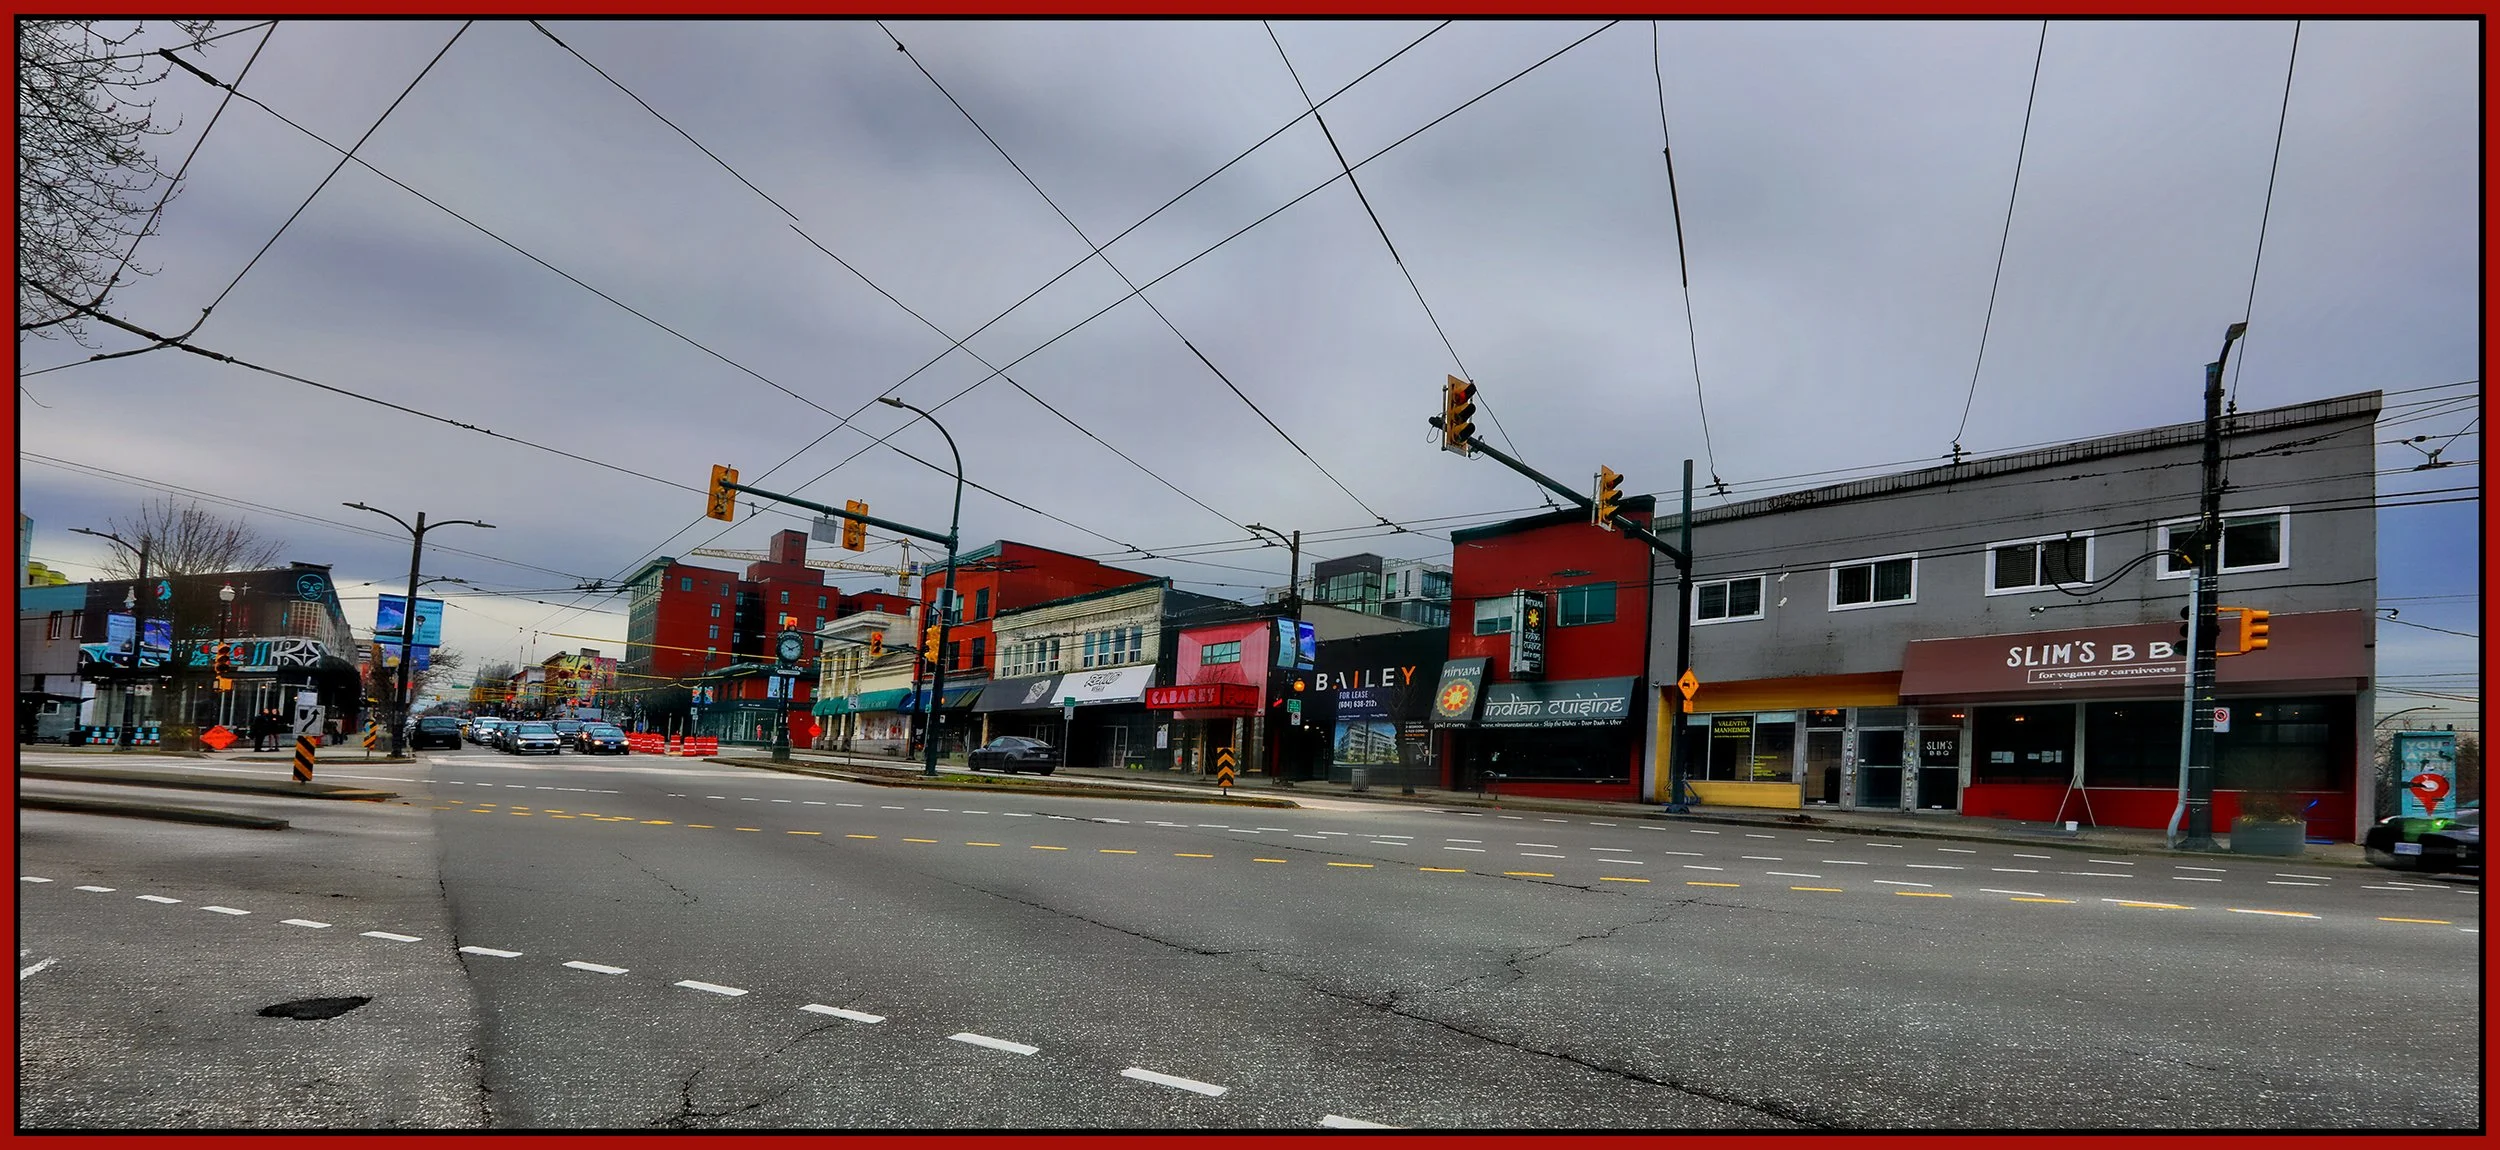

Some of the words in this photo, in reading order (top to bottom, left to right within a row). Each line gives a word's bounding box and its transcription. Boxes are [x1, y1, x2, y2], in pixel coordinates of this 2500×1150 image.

[2006, 640, 2096, 667] SLIM'S
[1315, 665, 1416, 691] BAILEY
[1443, 666, 1480, 678] nirvana
[2038, 670, 2055, 679] for
[2057, 670, 2096, 679] vegans
[2110, 666, 2177, 675] carnivores
[1151, 687, 1215, 705] CABARET
[1339, 691, 1350, 699] FOR
[1351, 690, 1369, 699] LEASE
[1485, 693, 1543, 717] indian
[1548, 692, 1625, 717] cuisine
[1926, 740, 1953, 751] SLIM'S
[2406, 741, 2441, 750] YOU
